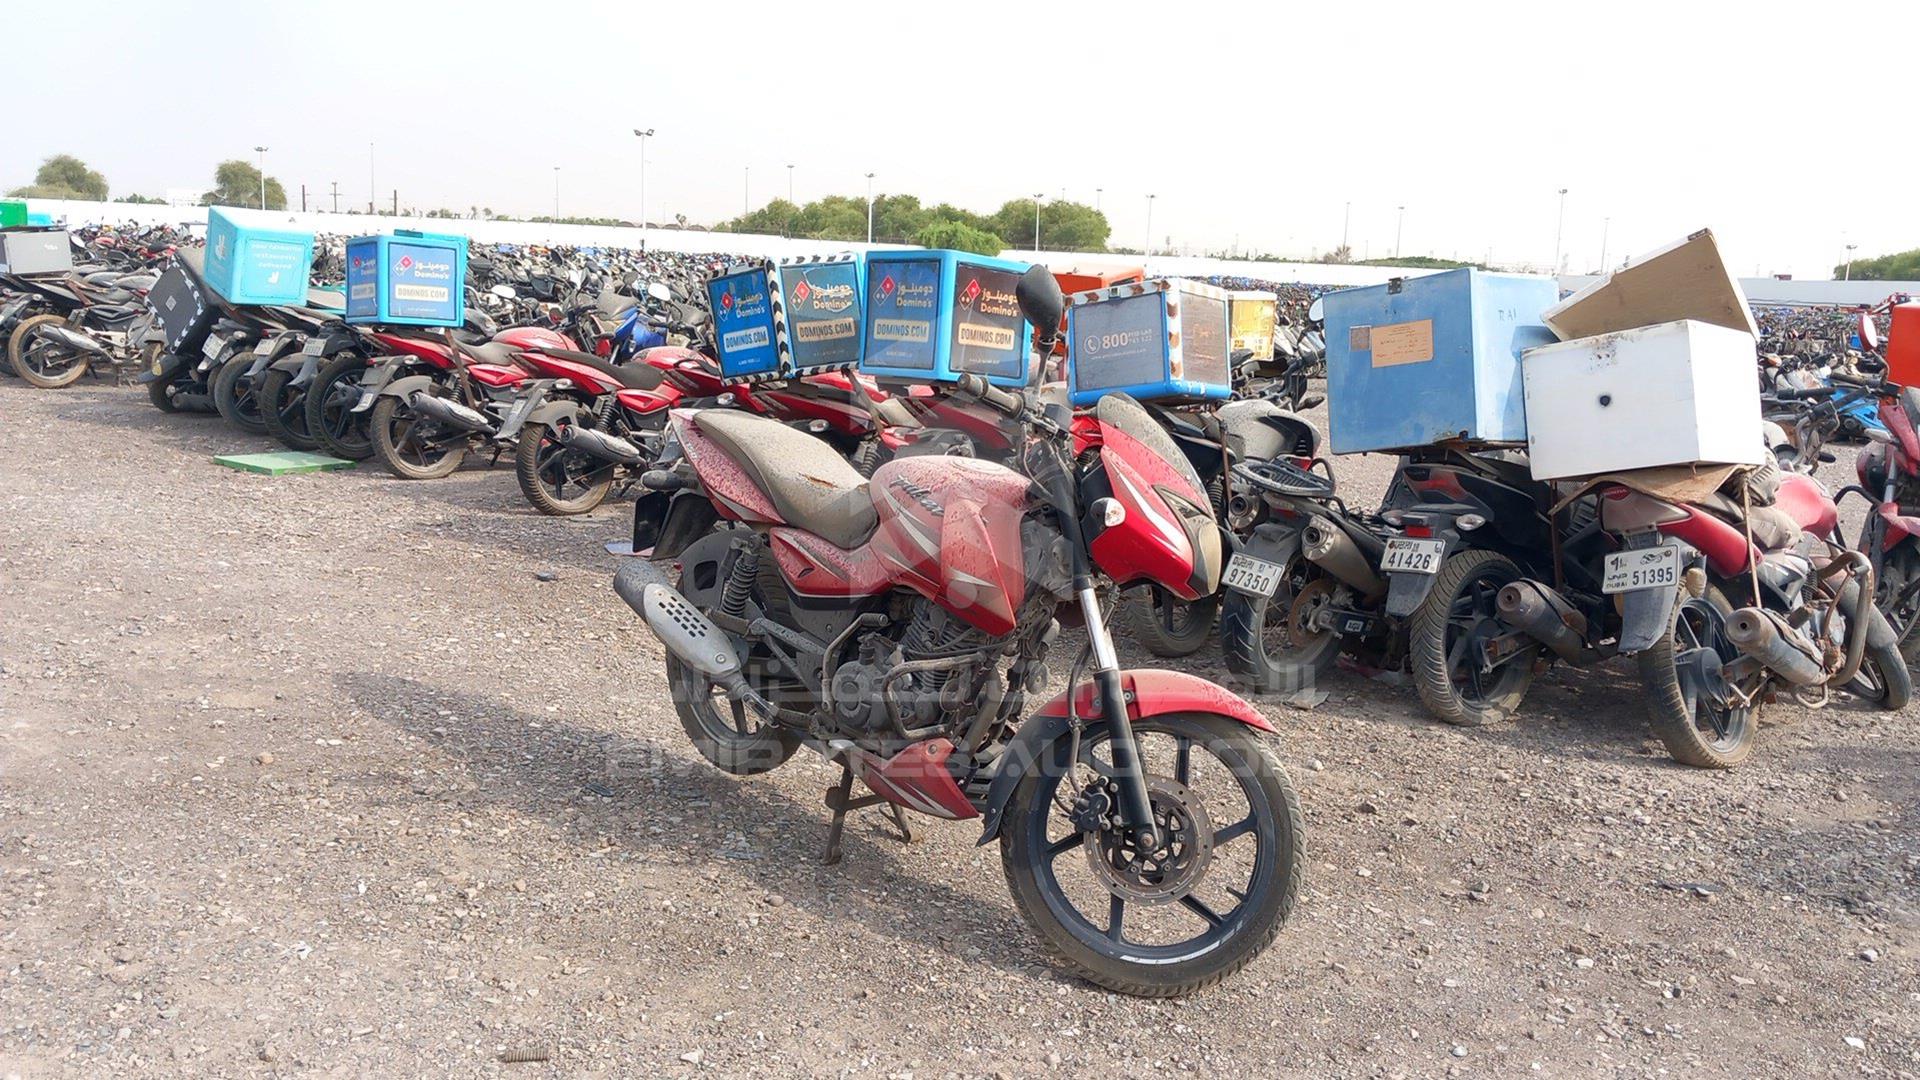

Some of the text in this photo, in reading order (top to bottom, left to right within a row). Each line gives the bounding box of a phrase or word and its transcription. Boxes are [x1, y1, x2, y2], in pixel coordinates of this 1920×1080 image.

[414, 270, 449, 279] Domino's
[896, 281, 934, 294] دومينوز
[896, 297, 932, 308] Domino's
[980, 302, 1018, 317] Domino's
[735, 305, 766, 318] Domino's
[799, 322, 853, 338] DOMINOS.COM
[876, 324, 927, 338] DOMINOS.COM
[961, 328, 1012, 344] DOMINOS.COM
[725, 331, 767, 348] DOMINOS.COM
[1102, 332, 1128, 349] 800
[1388, 552, 1431, 569] 41426
[1229, 568, 1270, 592] 97350
[1632, 566, 1674, 586] 51395
